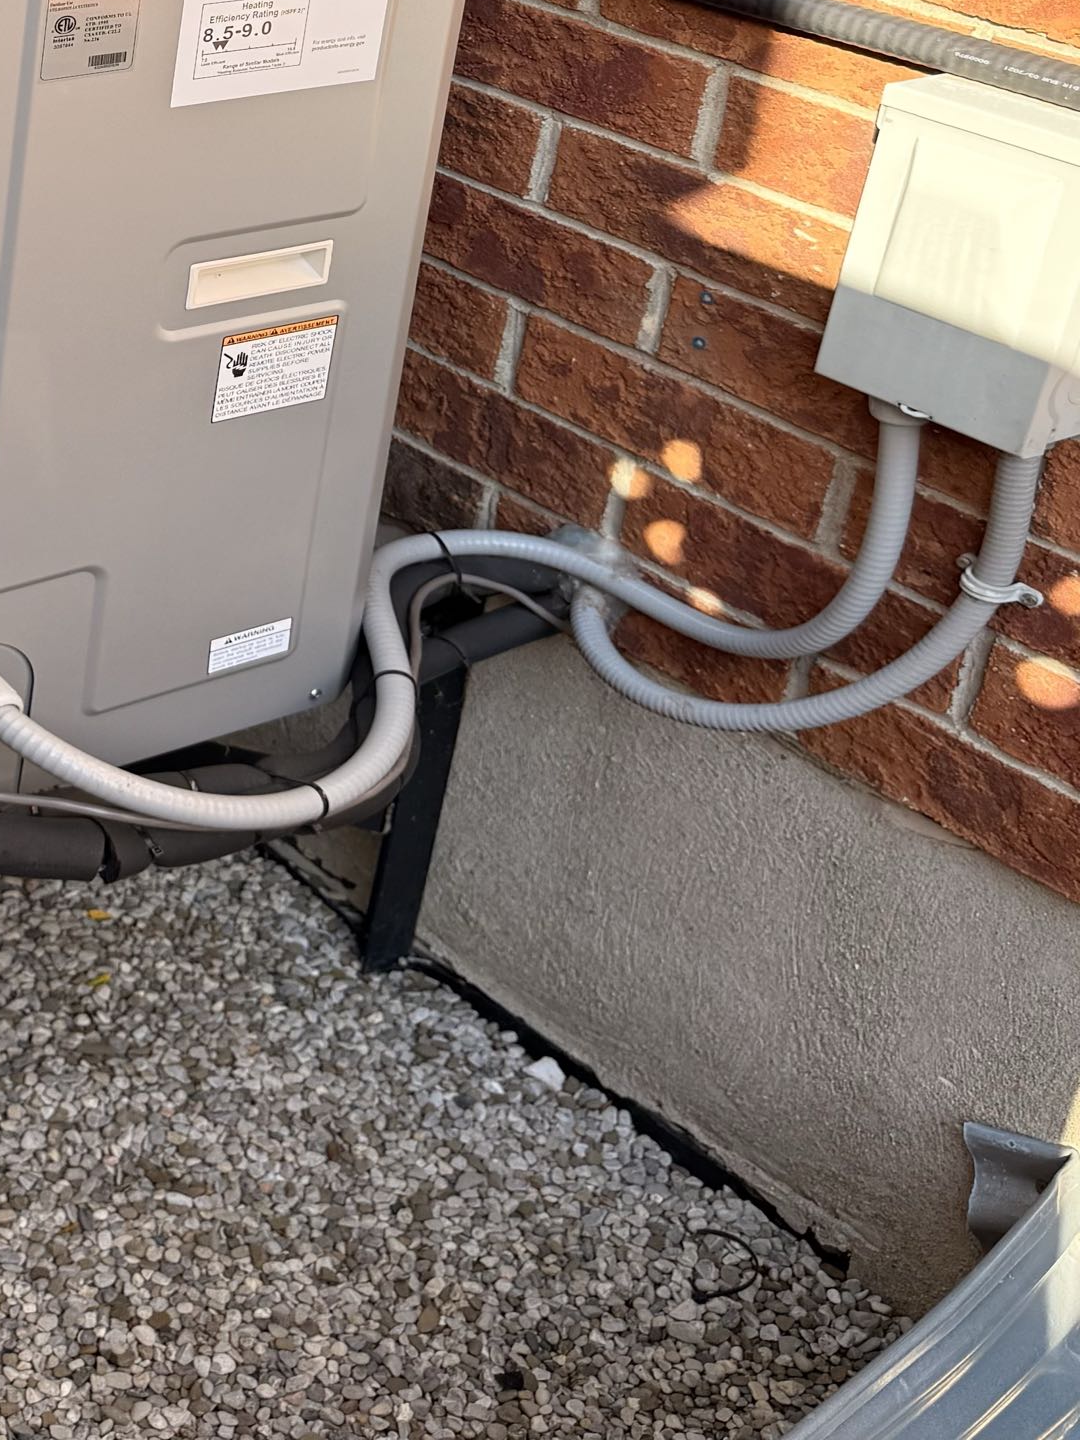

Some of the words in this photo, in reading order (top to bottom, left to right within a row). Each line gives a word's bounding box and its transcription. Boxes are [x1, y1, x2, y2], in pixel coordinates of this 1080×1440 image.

[242, 1, 274, 10] Heating
[210, 14, 250, 24] Efficiency
[252, 9, 279, 19] Rating
[58, 18, 74, 32] ETL
[203, 21, 272, 42] 8.5-9.0
[280, 319, 335, 333] AVERTISSEMENT
[278, 333, 308, 344] ELECTRIC
[311, 329, 333, 338] SHOCK
[251, 347, 266, 355] CAN
[268, 344, 291, 352] CAUSE
[275, 344, 317, 357] DISCONNECT
[276, 352, 305, 362] ELECTRIC
[282, 358, 309, 366] BEFORE
[215, 407, 247, 418] DISTANCE
